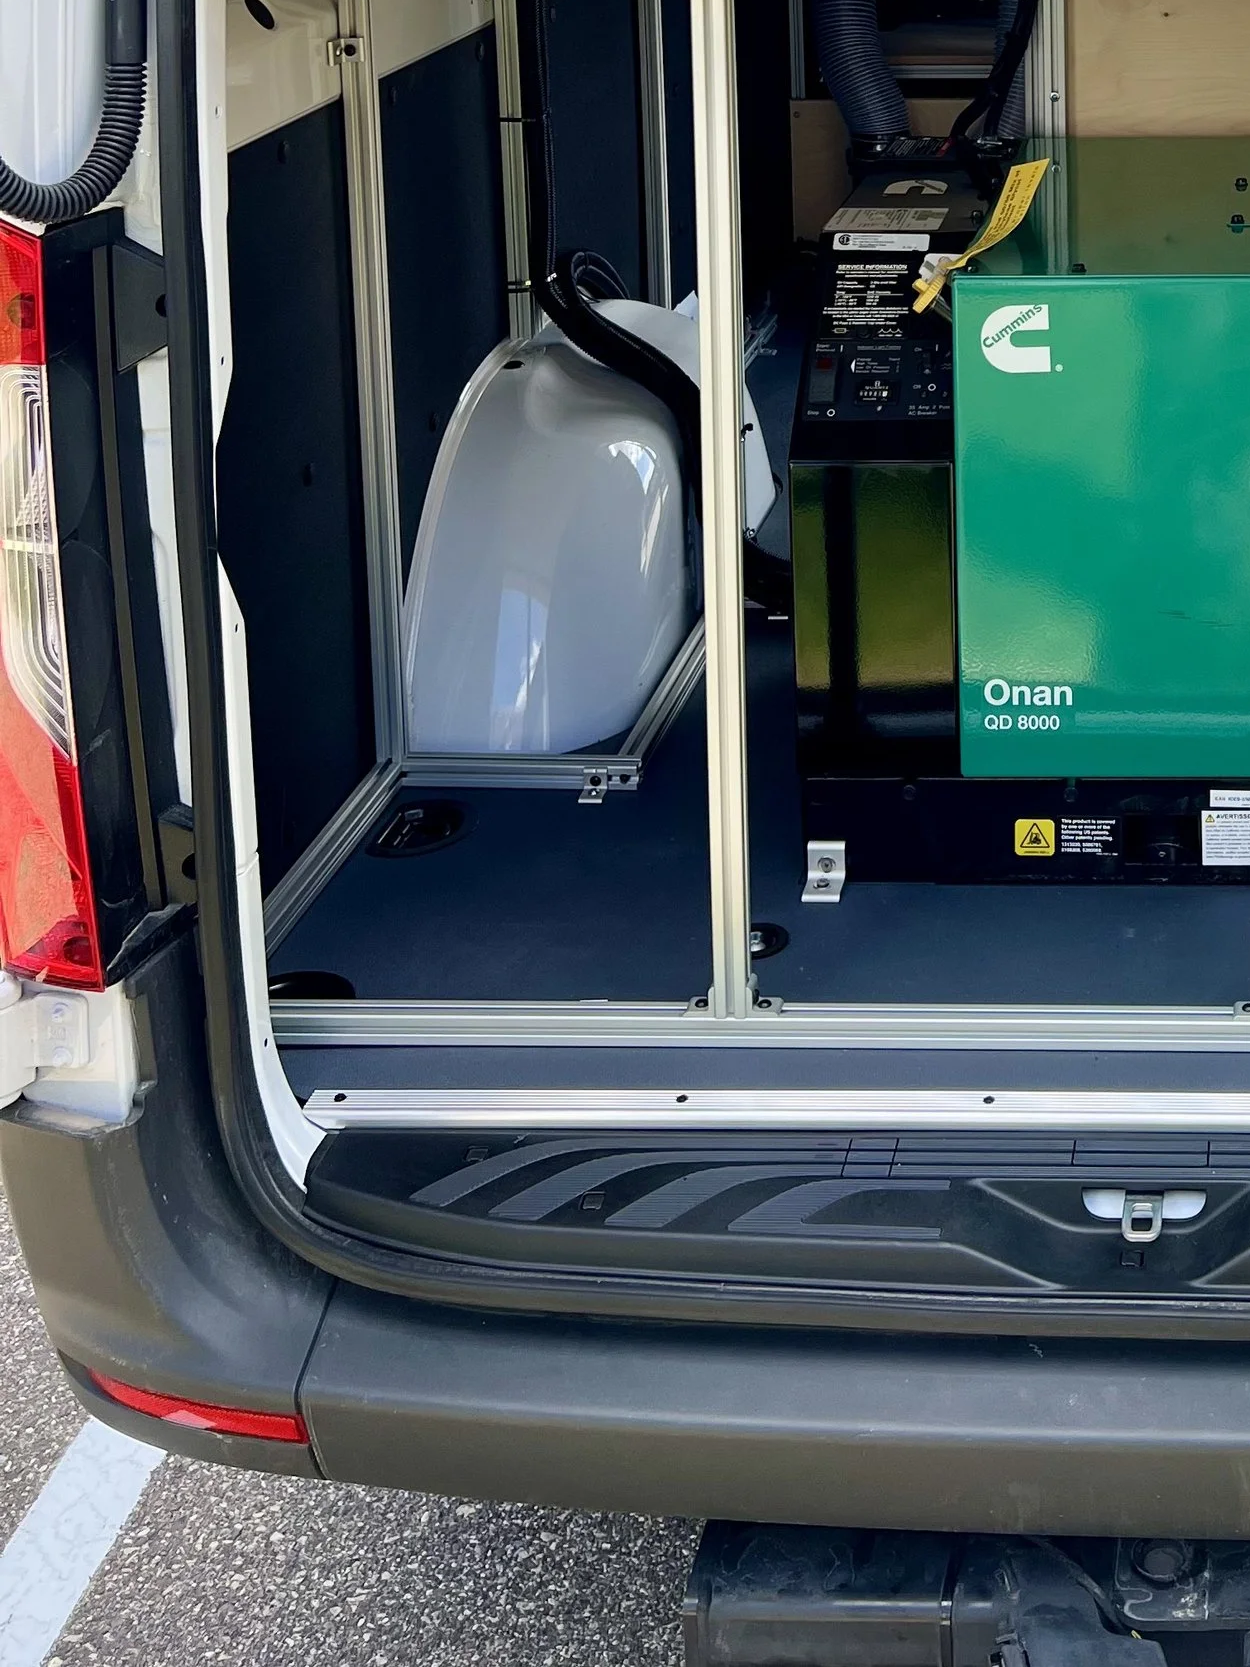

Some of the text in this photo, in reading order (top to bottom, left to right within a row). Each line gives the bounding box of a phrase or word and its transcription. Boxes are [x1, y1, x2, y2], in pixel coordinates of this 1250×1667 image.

[983, 304, 1043, 348] Cummins
[984, 678, 1073, 706] Onan
[984, 715, 1060, 730] QD 8000
